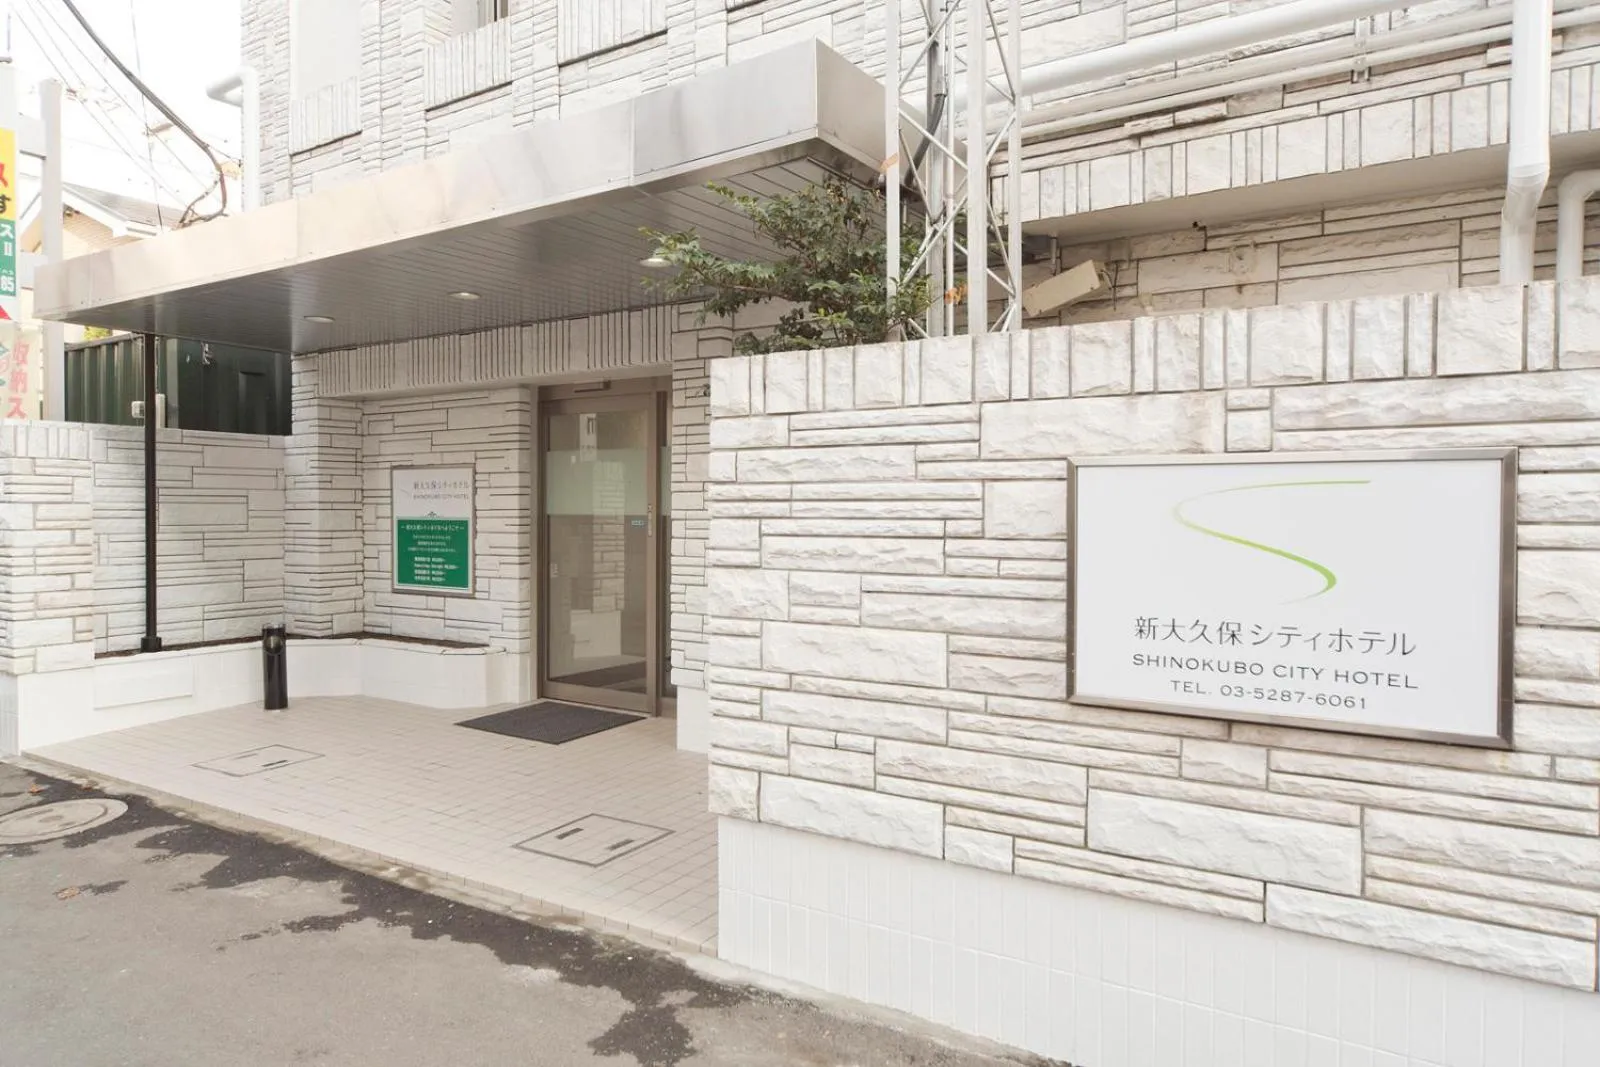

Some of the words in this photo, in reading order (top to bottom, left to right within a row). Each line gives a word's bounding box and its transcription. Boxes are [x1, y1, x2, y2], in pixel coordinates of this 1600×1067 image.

[1134, 616, 1417, 656] 新大久保シティホテル
[1132, 653, 1265, 676] SHINOKUBO
[1273, 663, 1326, 682] CITY
[1334, 669, 1419, 690] HOTEL
[1170, 679, 1213, 695] TEL.
[1220, 684, 1367, 710] 03-5287-6061
